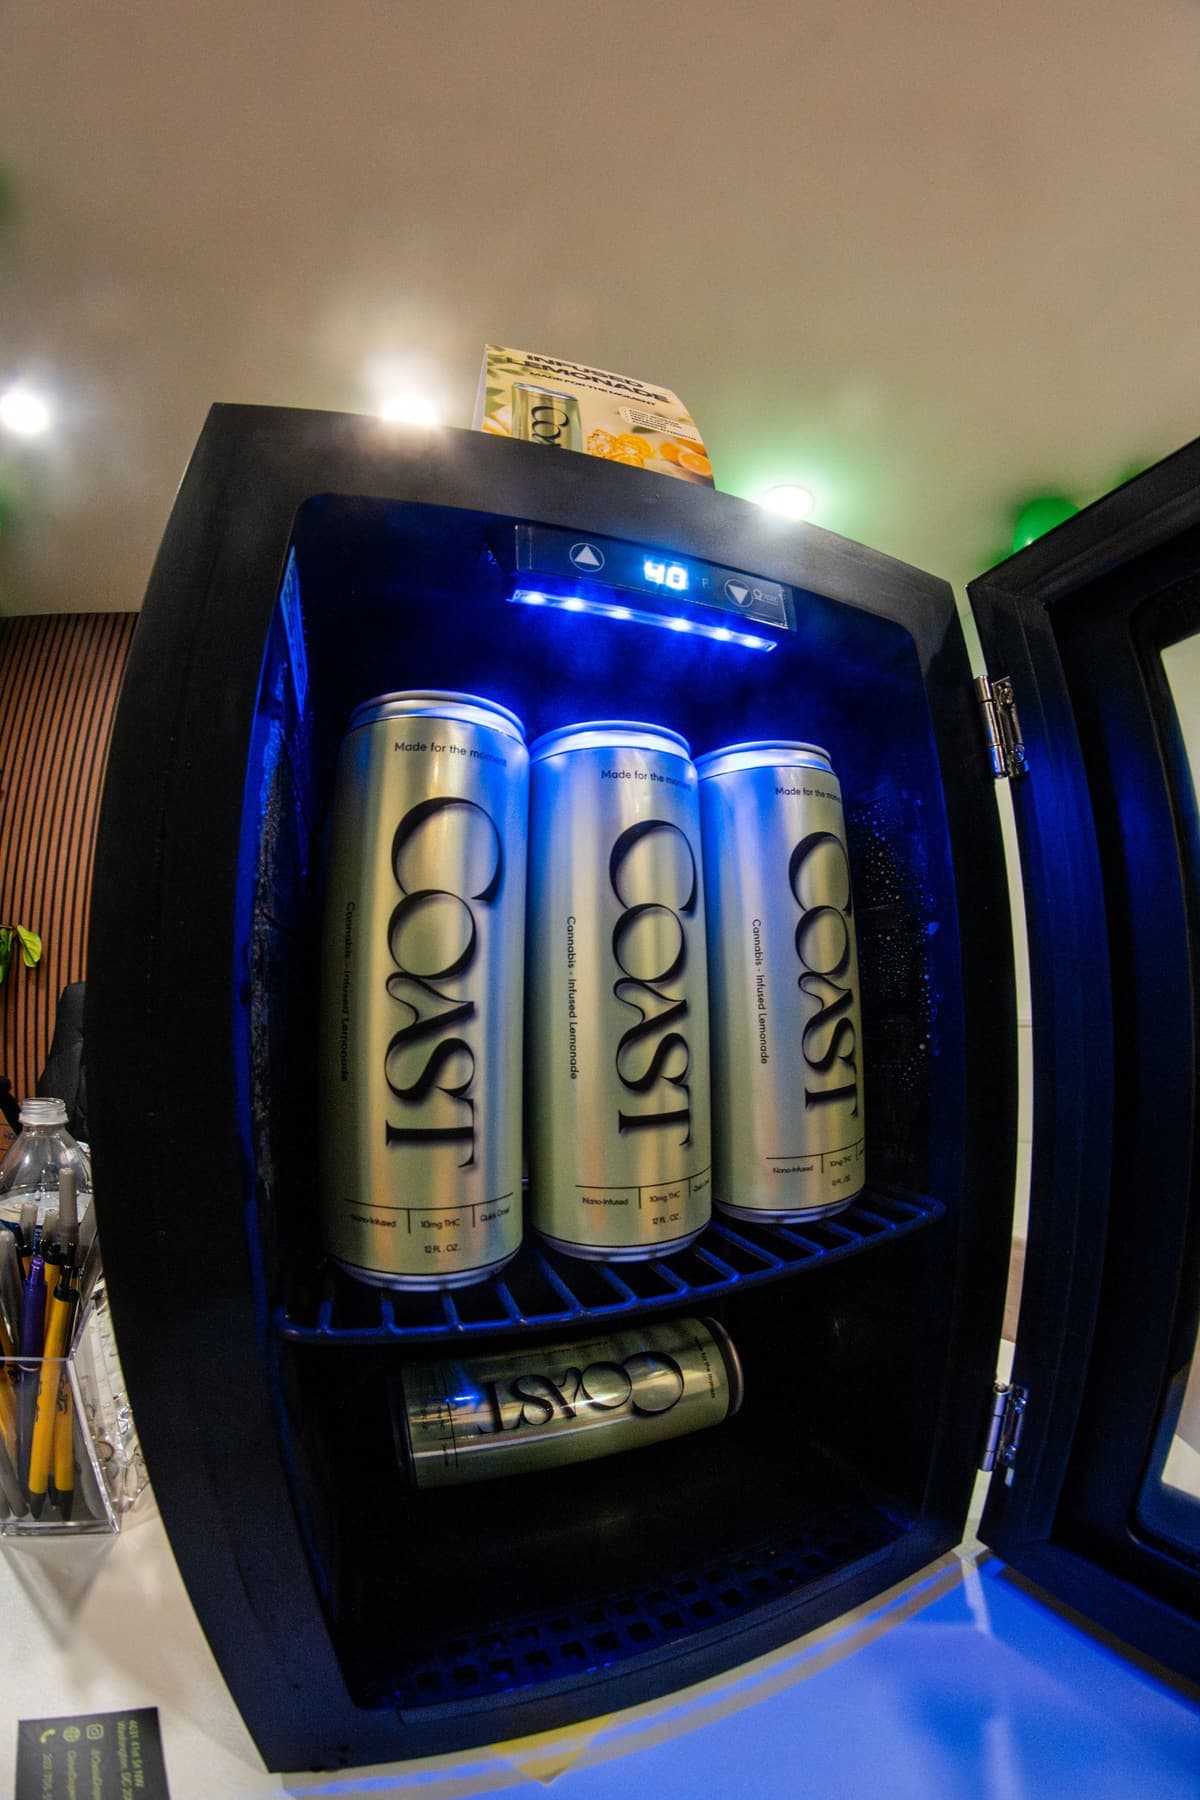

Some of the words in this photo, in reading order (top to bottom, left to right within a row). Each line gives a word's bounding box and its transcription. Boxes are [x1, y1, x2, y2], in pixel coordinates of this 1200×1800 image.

[506, 357, 671, 404] LEMONADE
[526, 355, 644, 388] INFUSED
[394, 741, 427, 752] Made
[430, 742, 446, 753] for
[449, 744, 467, 756] the
[601, 769, 631, 779] Made
[634, 770, 647, 780] for
[650, 773, 665, 783] the
[775, 787, 801, 796] Made
[803, 787, 814, 796] for
[567, 916, 577, 969] Cannabis
[752, 919, 764, 966] Cannabis
[384, 796, 501, 1168] COAST
[609, 819, 697, 1146] COAST
[756, 974, 766, 1010] Infused
[788, 831, 858, 1116] COAST
[568, 979, 578, 1018] Infused
[568, 1022, 580, 1080] Lemonade
[758, 1014, 769, 1064] Lemonade
[421, 1219, 443, 1230] 10mg
[444, 1217, 462, 1227] THC
[582, 1196, 629, 1206] Nano-Infused
[477, 1351, 685, 1435] COAST
